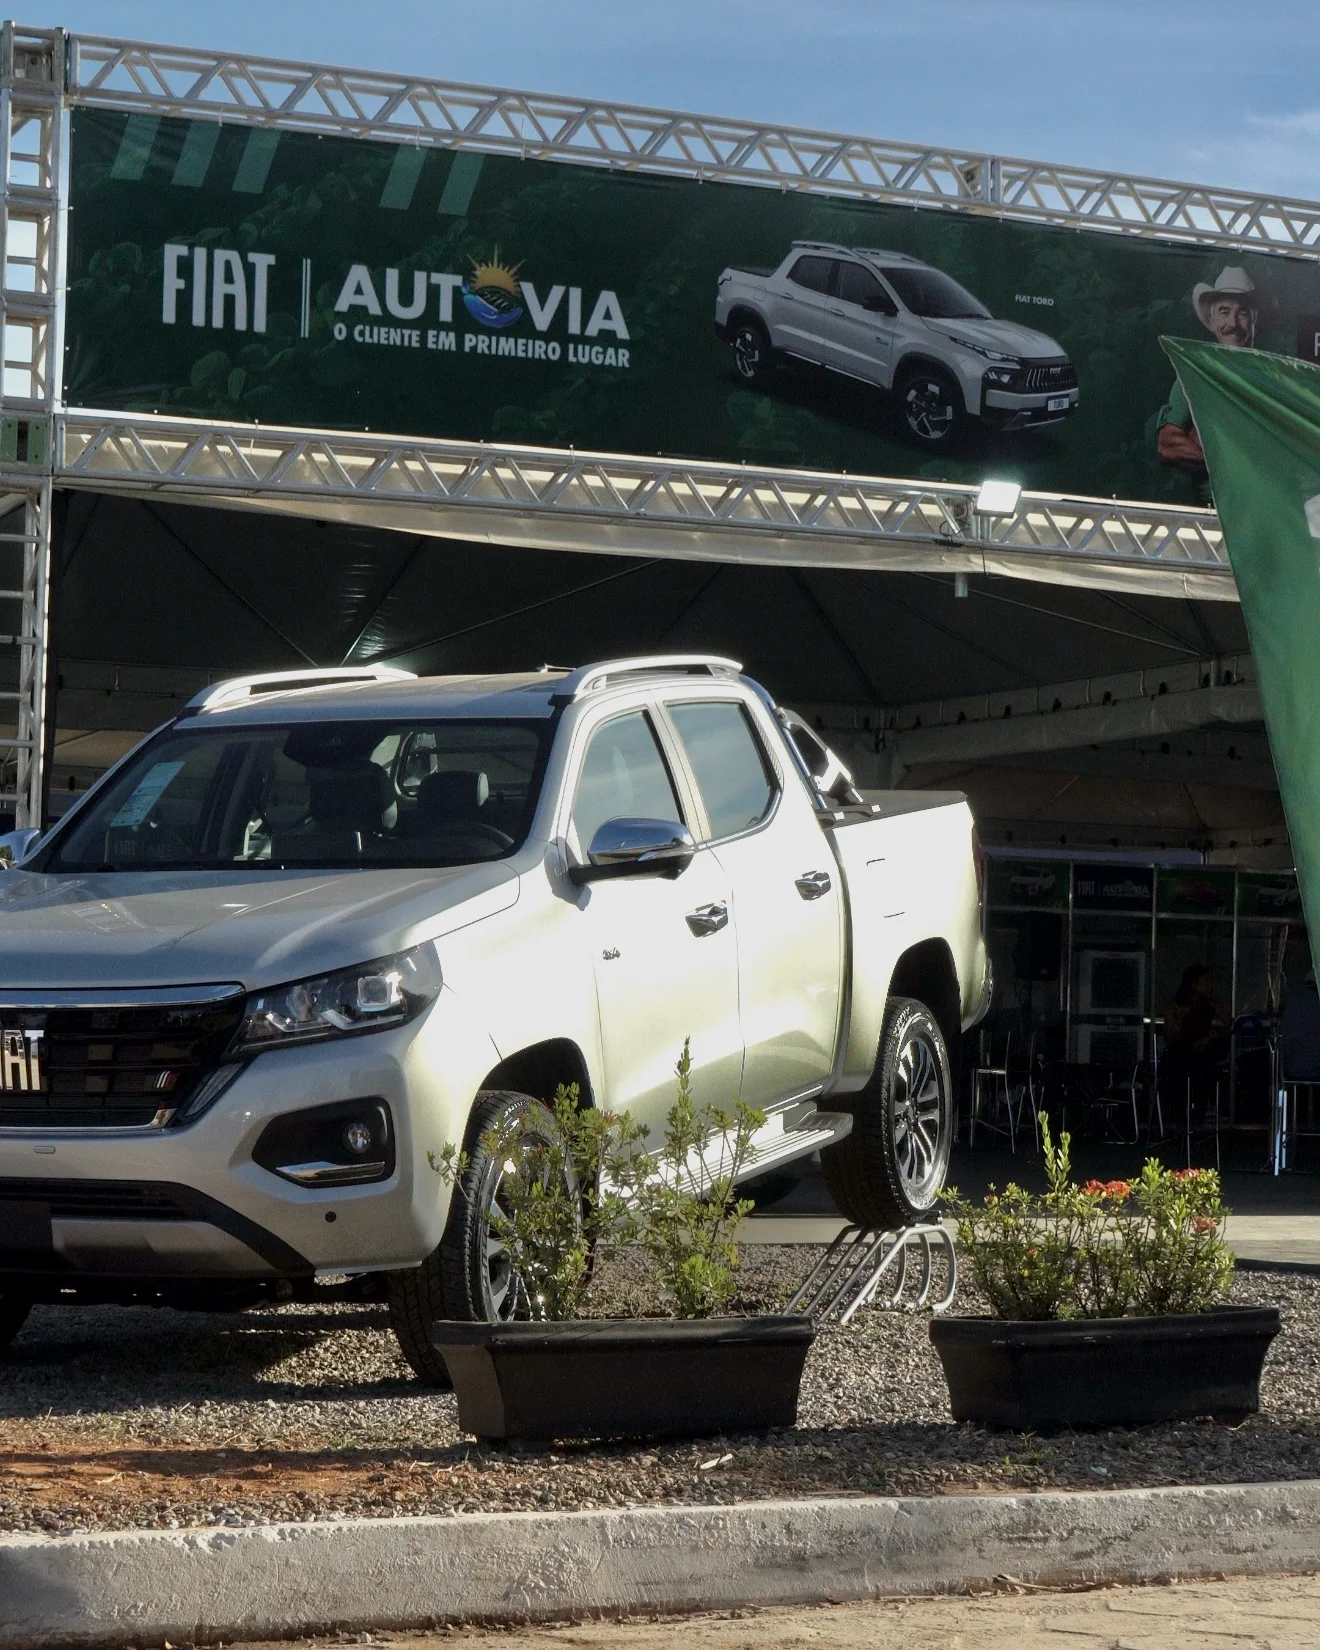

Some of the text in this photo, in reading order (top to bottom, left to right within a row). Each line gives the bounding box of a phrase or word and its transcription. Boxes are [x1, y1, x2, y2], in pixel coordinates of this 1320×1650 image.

[162, 243, 276, 333] FIAT
[1015, 294, 1054, 306] FIAT TORO
[333, 322, 630, 368] O CLIENTE EM PRIMEIRO LUGAR
